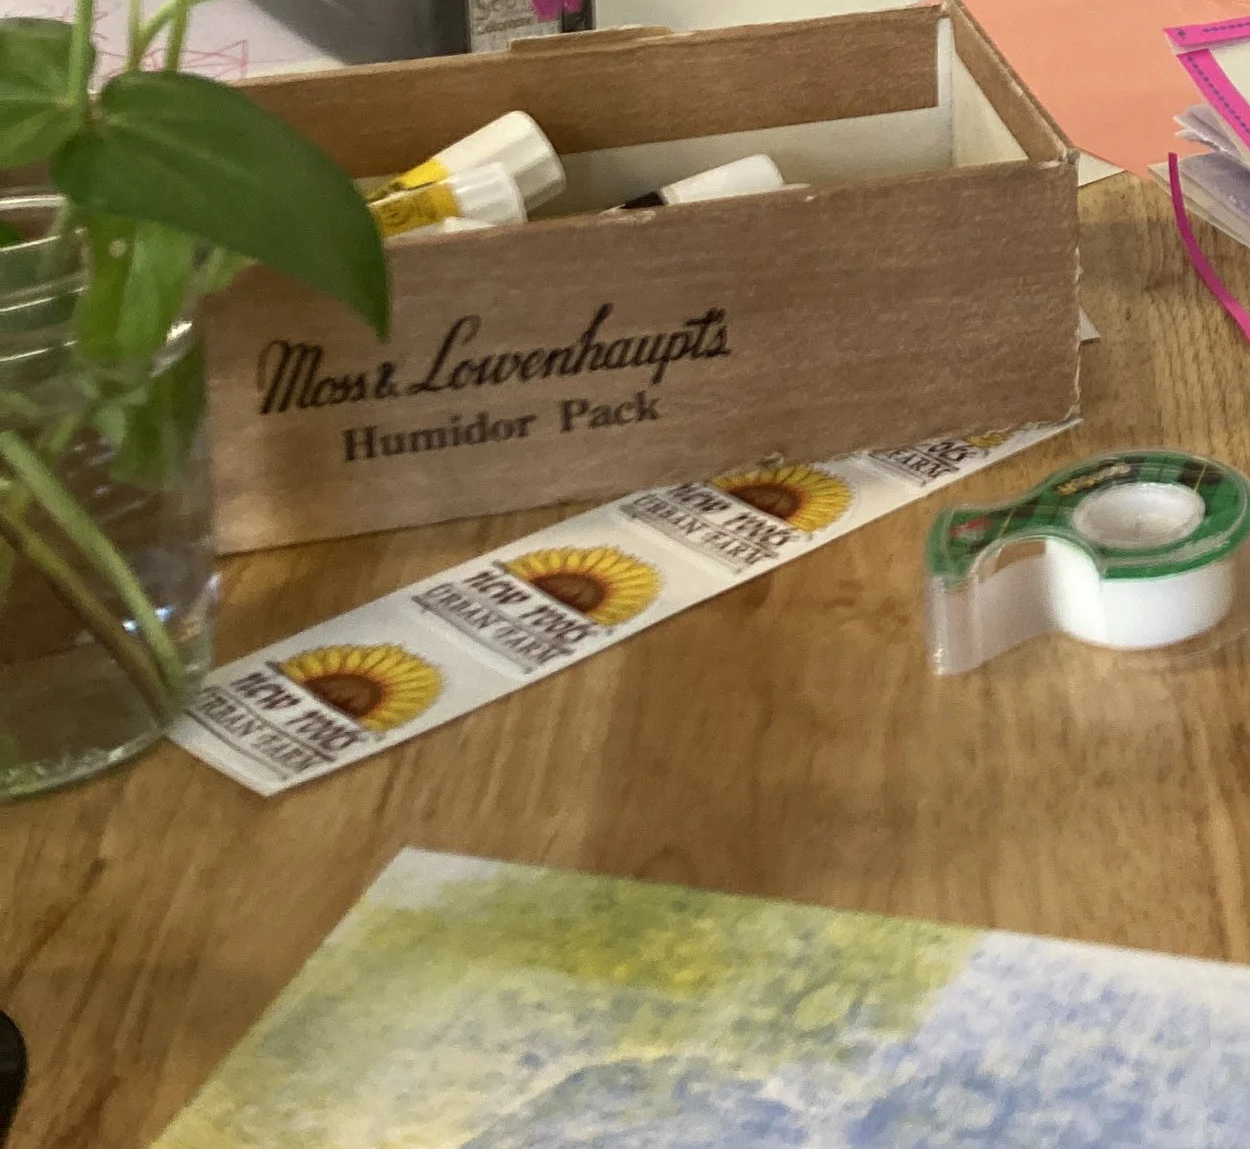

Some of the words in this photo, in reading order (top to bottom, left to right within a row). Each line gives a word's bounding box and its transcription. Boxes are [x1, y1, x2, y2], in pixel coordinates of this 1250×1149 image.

[257, 337, 367, 415] Moss
[341, 410, 538, 463] Humidor
[559, 390, 661, 434] Pack
[631, 493, 710, 536] URBAN
